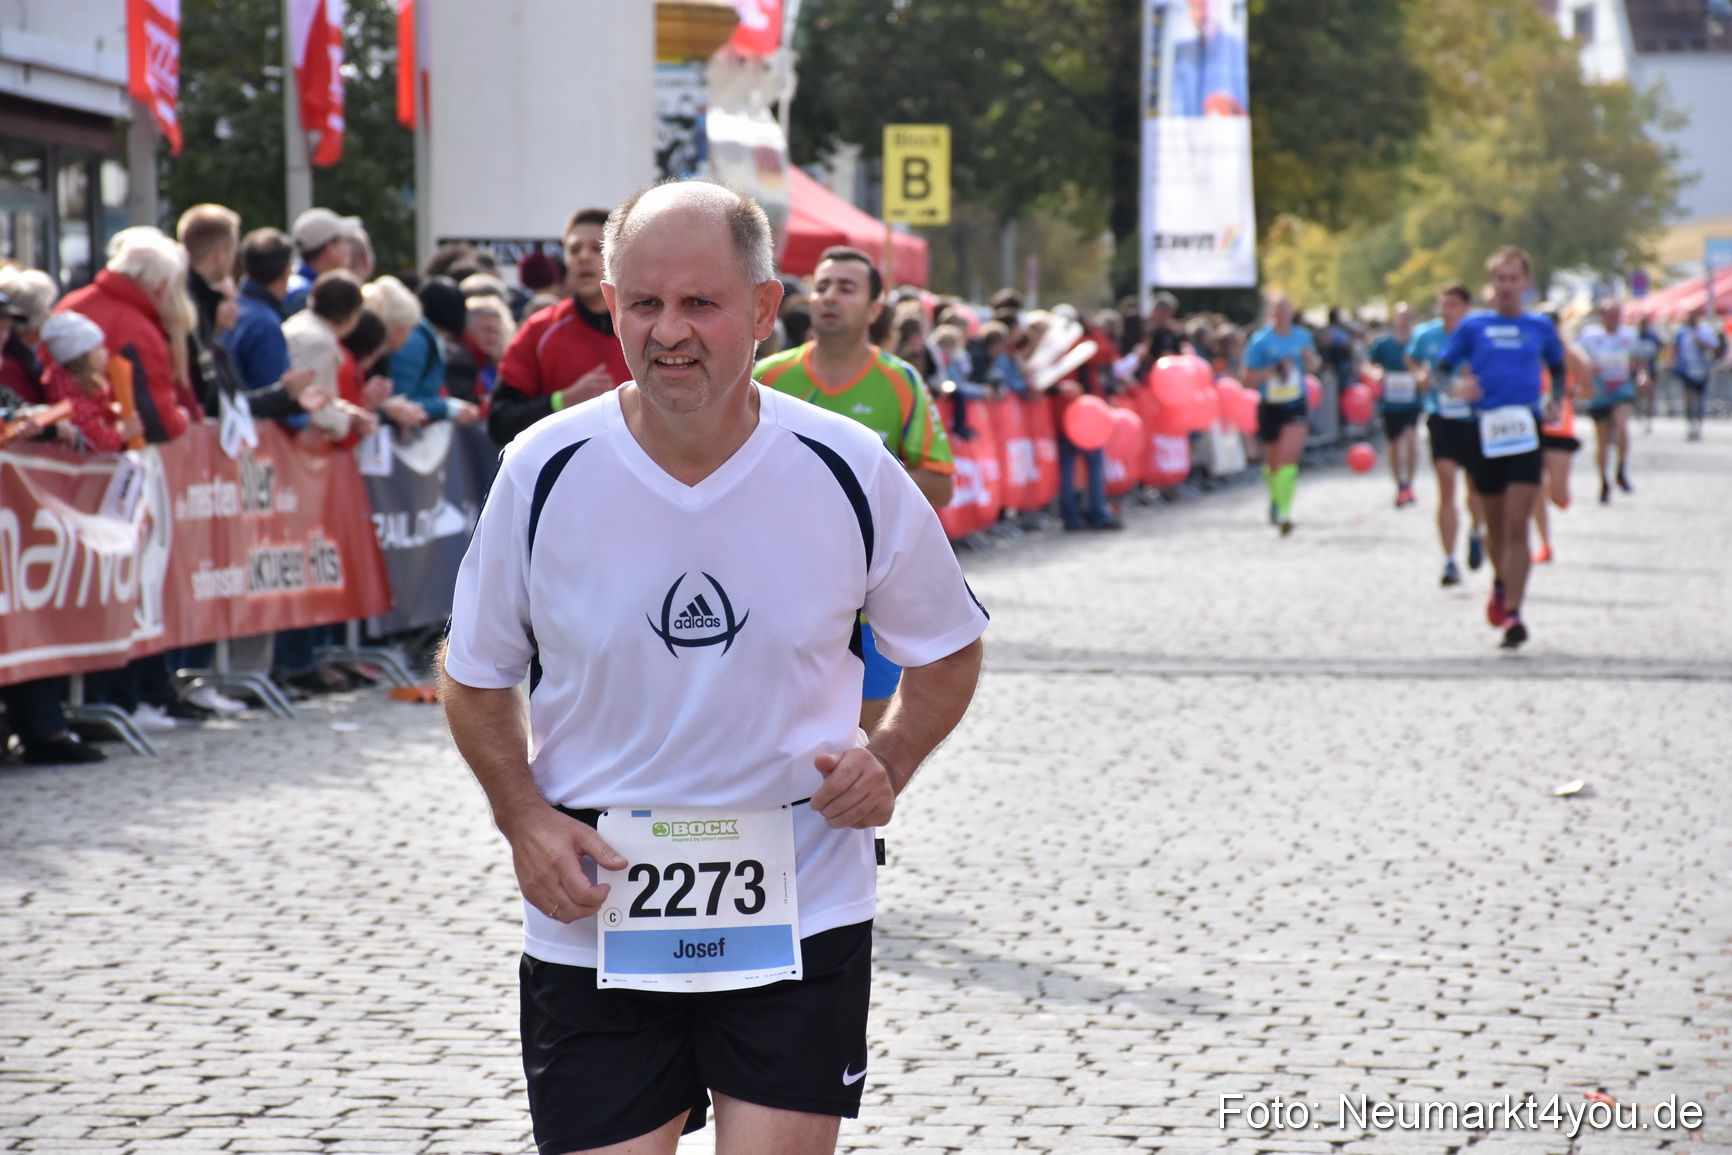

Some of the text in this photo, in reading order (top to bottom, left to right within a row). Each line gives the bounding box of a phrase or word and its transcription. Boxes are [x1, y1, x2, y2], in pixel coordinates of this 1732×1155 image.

[902, 156, 931, 200] B
[674, 616, 720, 629] adidas
[672, 819, 738, 836] BOCK
[628, 859, 766, 918] 2273
[609, 912, 617, 923] C
[673, 937, 726, 959] Josef
